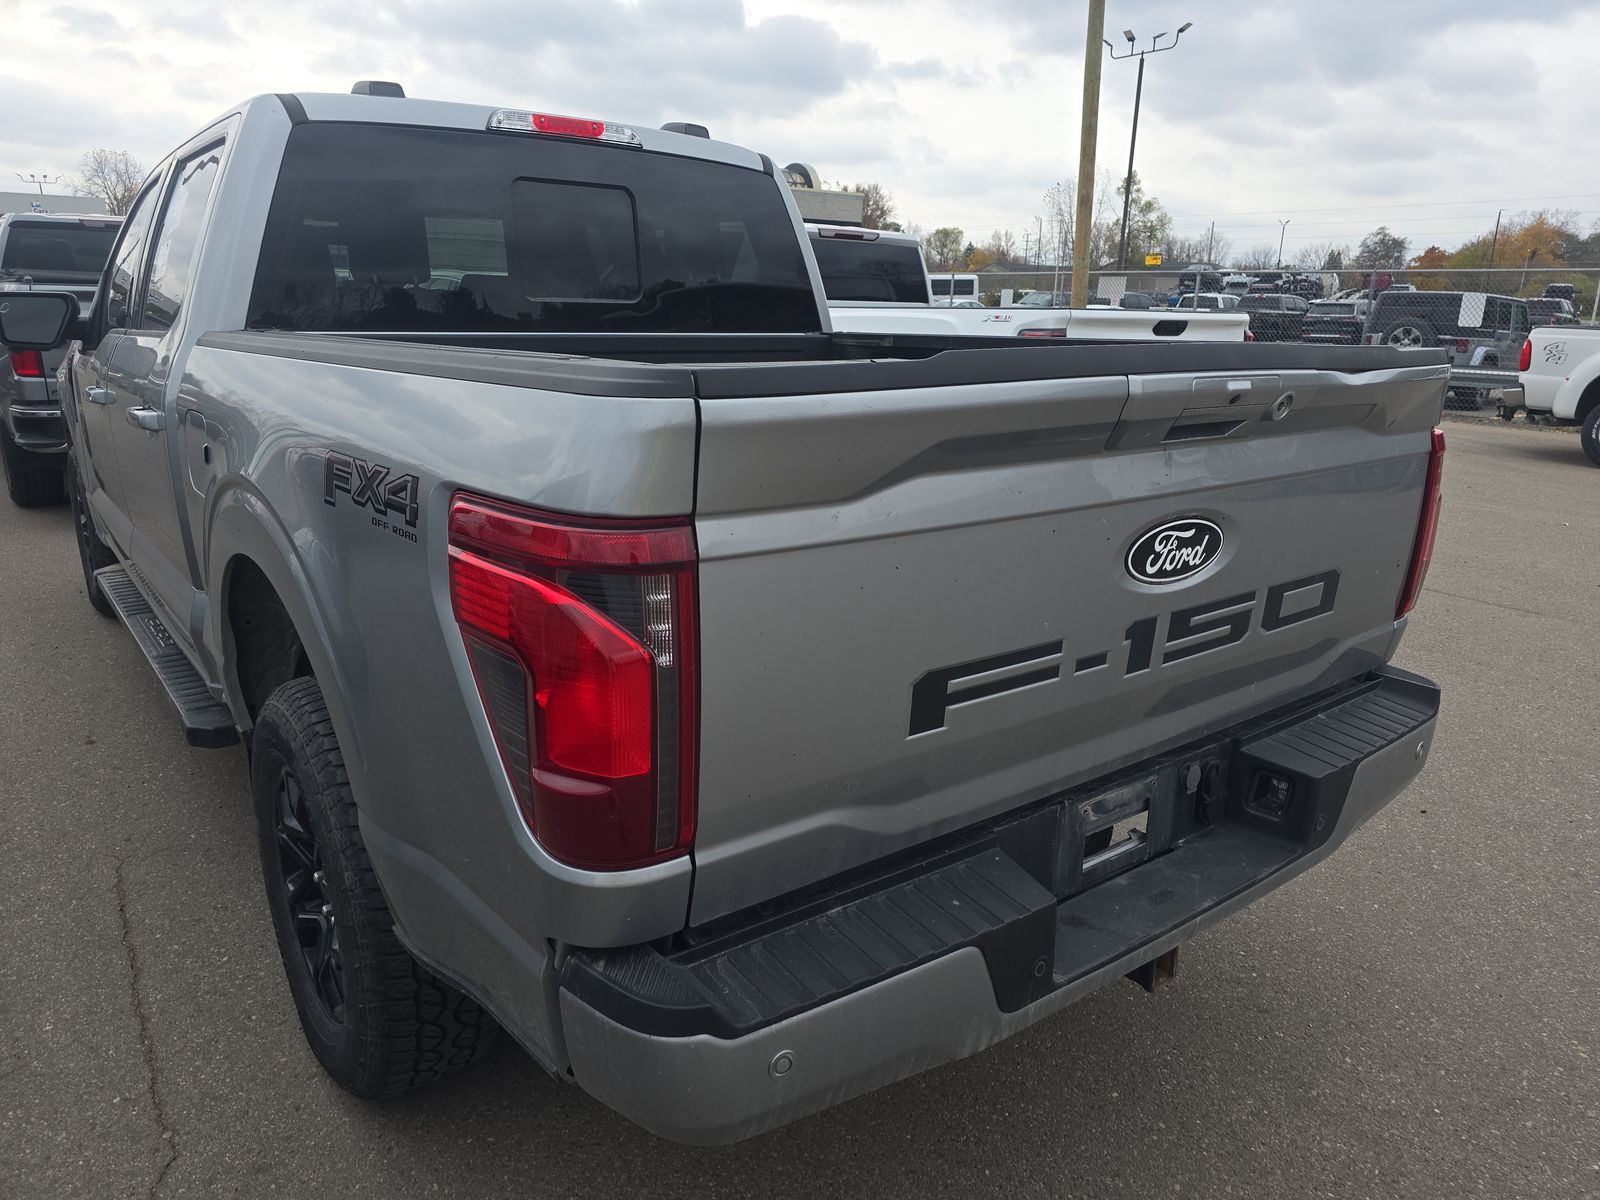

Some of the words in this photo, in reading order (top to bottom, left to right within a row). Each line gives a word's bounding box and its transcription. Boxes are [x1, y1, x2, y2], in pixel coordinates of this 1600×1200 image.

[323, 449, 420, 529] FX4
[371, 517, 389, 530] OFF
[391, 525, 418, 544] ROAD
[1145, 528, 1210, 575] Ford
[906, 568, 1340, 741] F-150
